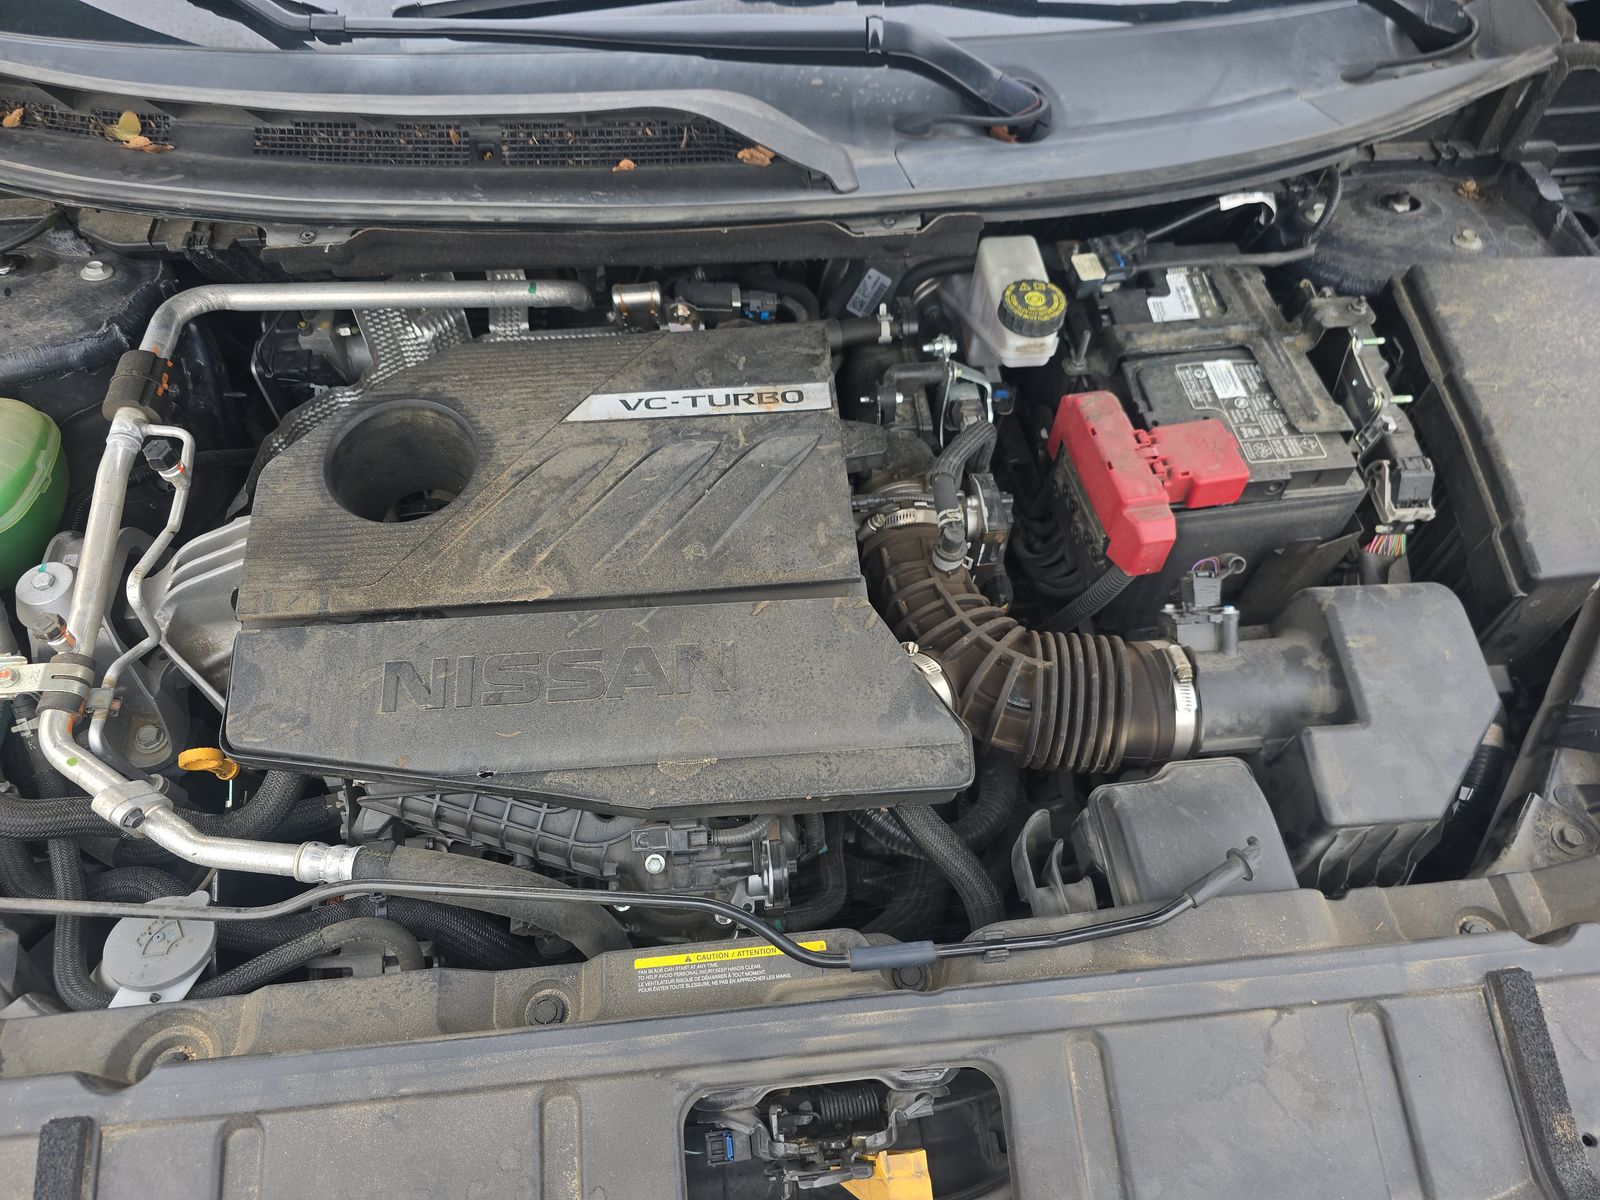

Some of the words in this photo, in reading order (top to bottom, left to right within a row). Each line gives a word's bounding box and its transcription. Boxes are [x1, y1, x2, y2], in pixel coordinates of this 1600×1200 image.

[619, 389, 804, 411] VC-TURBO
[379, 641, 738, 714] NISSAN
[696, 952, 729, 961] CAUTION
[736, 948, 777, 957] ATTENTION
[645, 978, 675, 987] VENTILATEUR
[676, 976, 693, 984] RISQUE
[701, 973, 727, 981] DÉMARRER
[673, 969, 699, 977] PERSONAL
[653, 984, 670, 992] ÉVITER
[737, 974, 766, 983] APPROCHER
